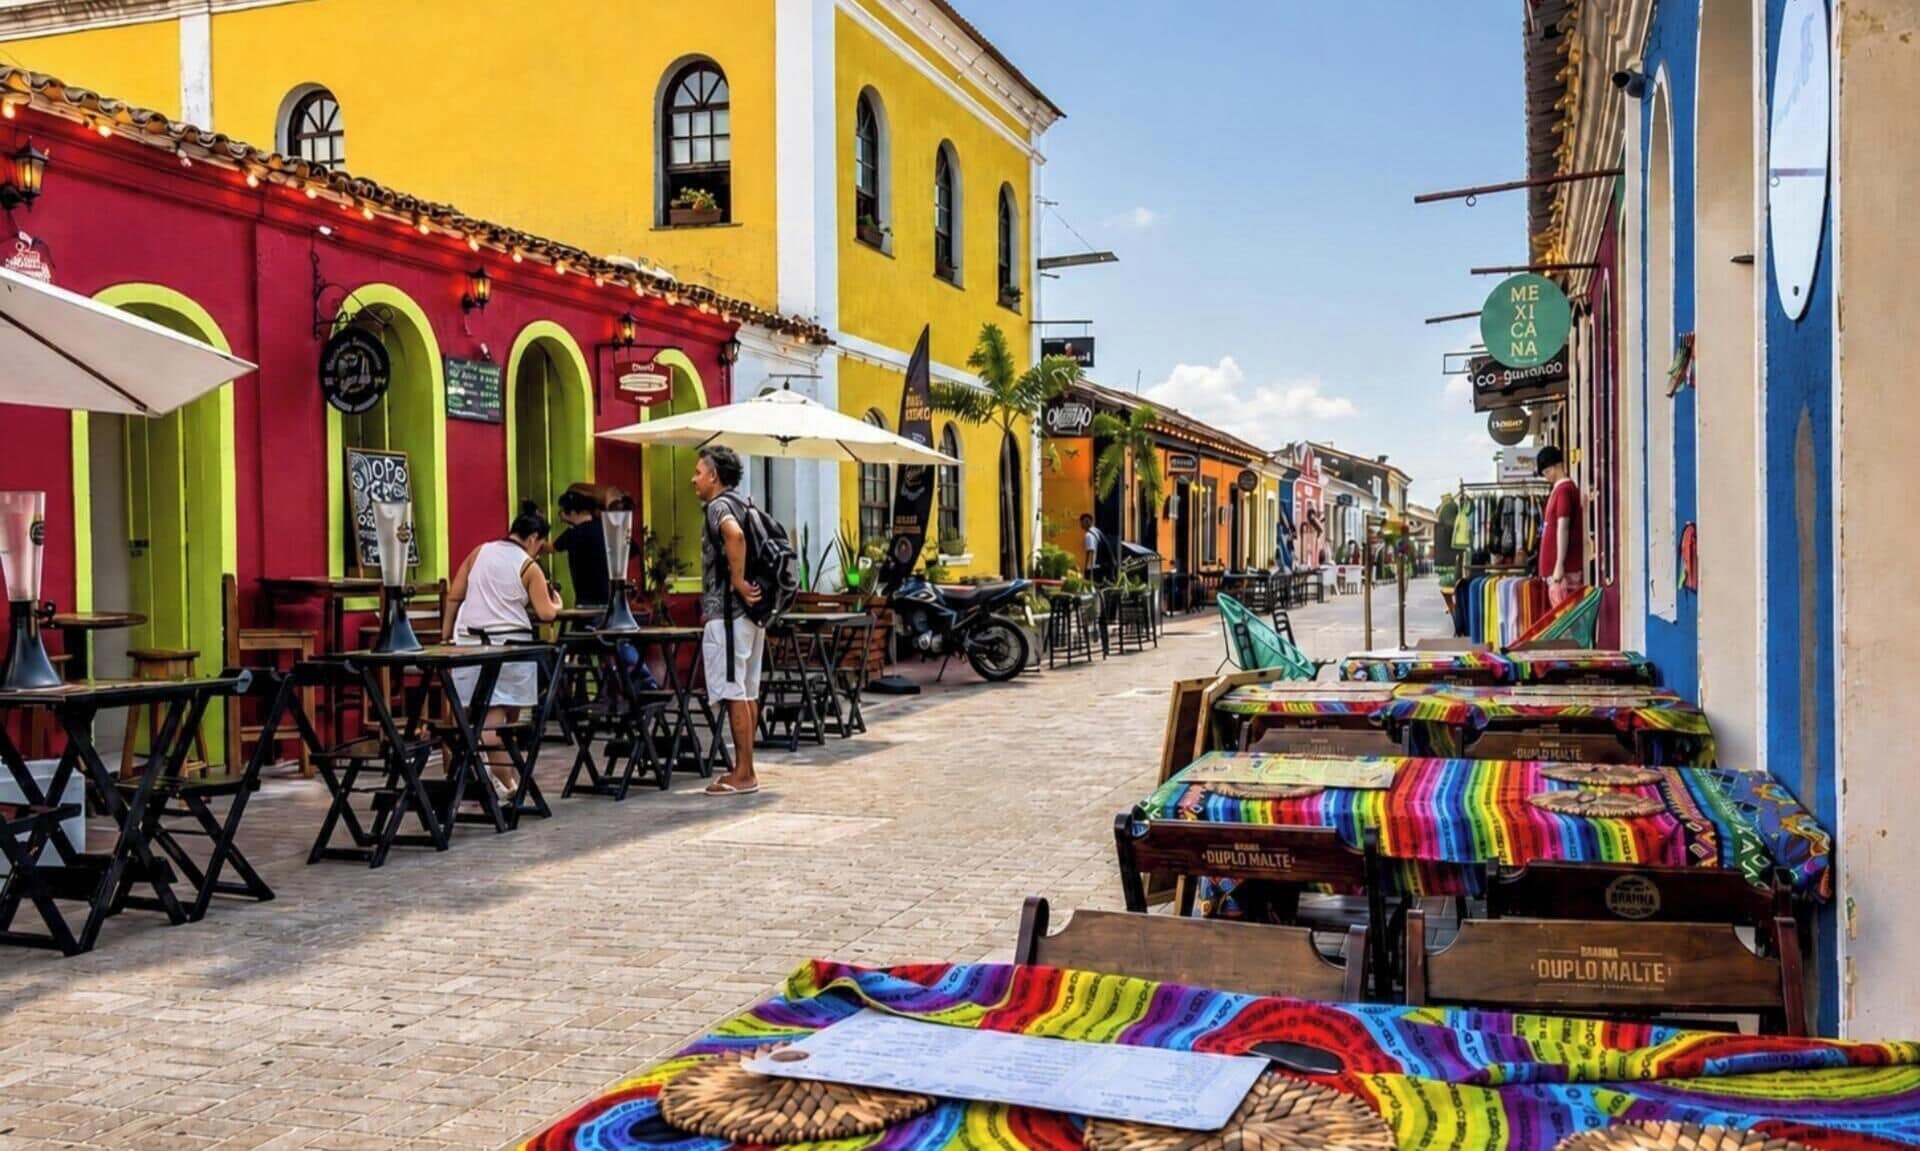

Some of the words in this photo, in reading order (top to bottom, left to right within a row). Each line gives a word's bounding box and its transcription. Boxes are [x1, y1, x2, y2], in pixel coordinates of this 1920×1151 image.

[1511, 284, 1539, 302] ME
[1514, 303, 1535, 320] XI
[1511, 321, 1537, 338] CA
[1511, 340, 1538, 357] NA
[1206, 850, 1246, 865] DUPLO
[1249, 852, 1292, 868] MALTE
[1538, 958, 1597, 980] DUPLO
[1602, 961, 1665, 983] MALTE
